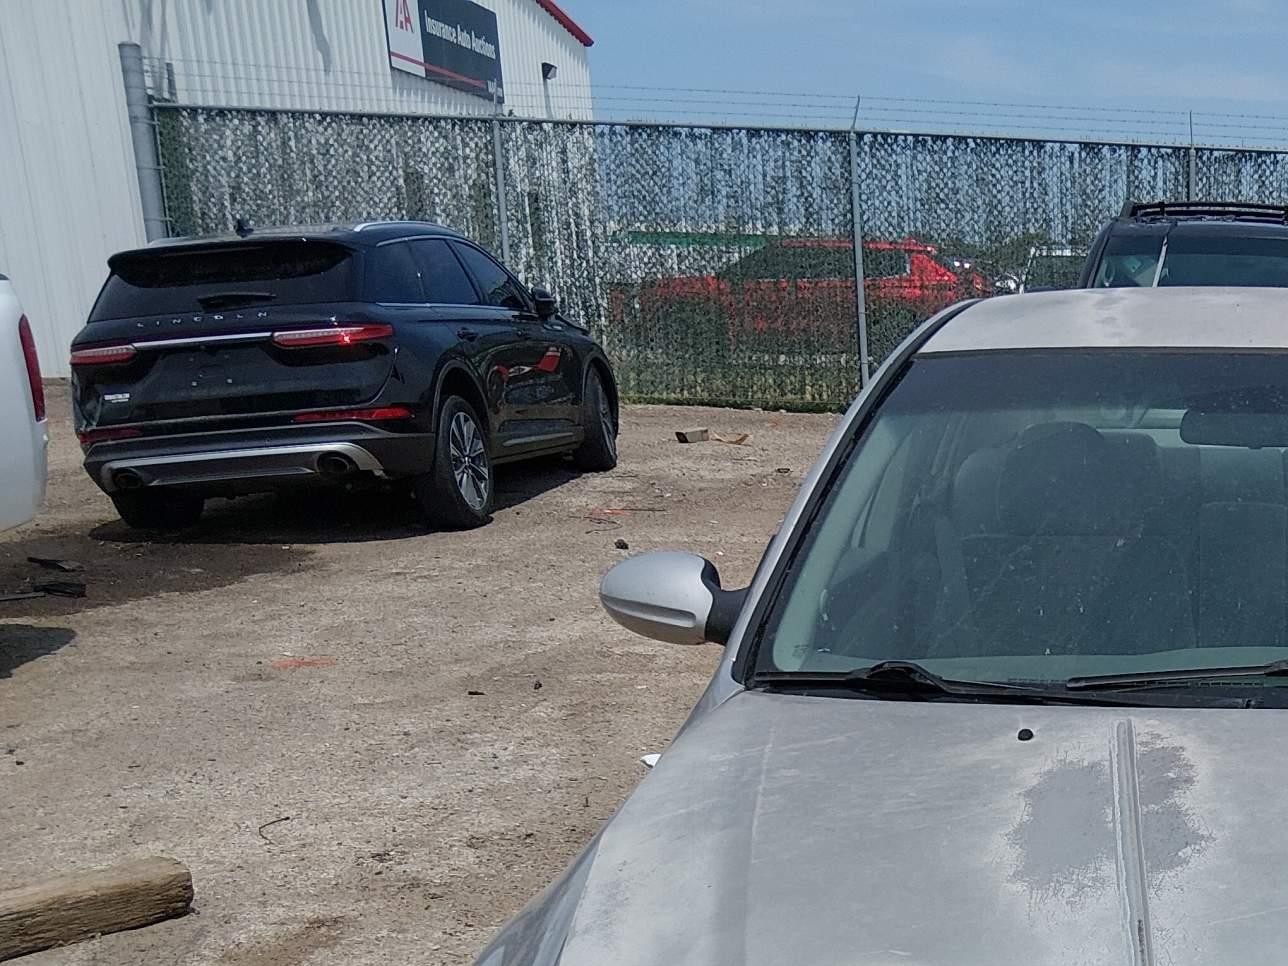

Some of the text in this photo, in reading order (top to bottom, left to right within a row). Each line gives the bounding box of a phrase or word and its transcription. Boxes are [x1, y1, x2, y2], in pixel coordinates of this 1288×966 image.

[424, 9, 497, 60] Insurance Auto Auctions
